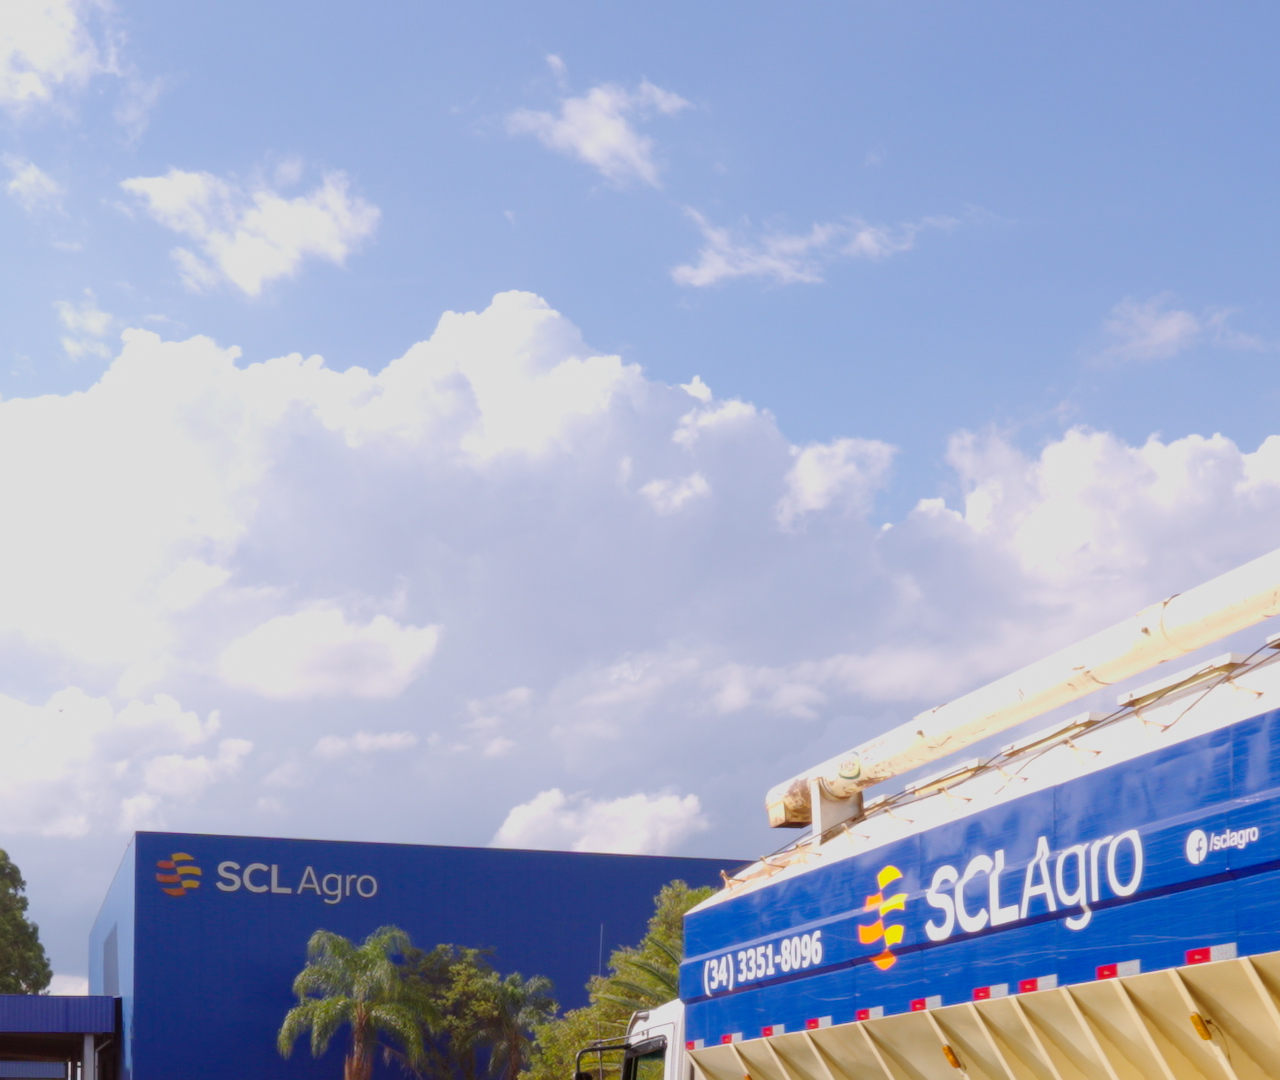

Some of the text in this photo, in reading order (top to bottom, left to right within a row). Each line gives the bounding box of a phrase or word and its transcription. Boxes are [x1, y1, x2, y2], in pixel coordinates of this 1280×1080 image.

[216, 861, 378, 904] SCL Agro
[703, 931, 823, 997] (34) 3351-8096
